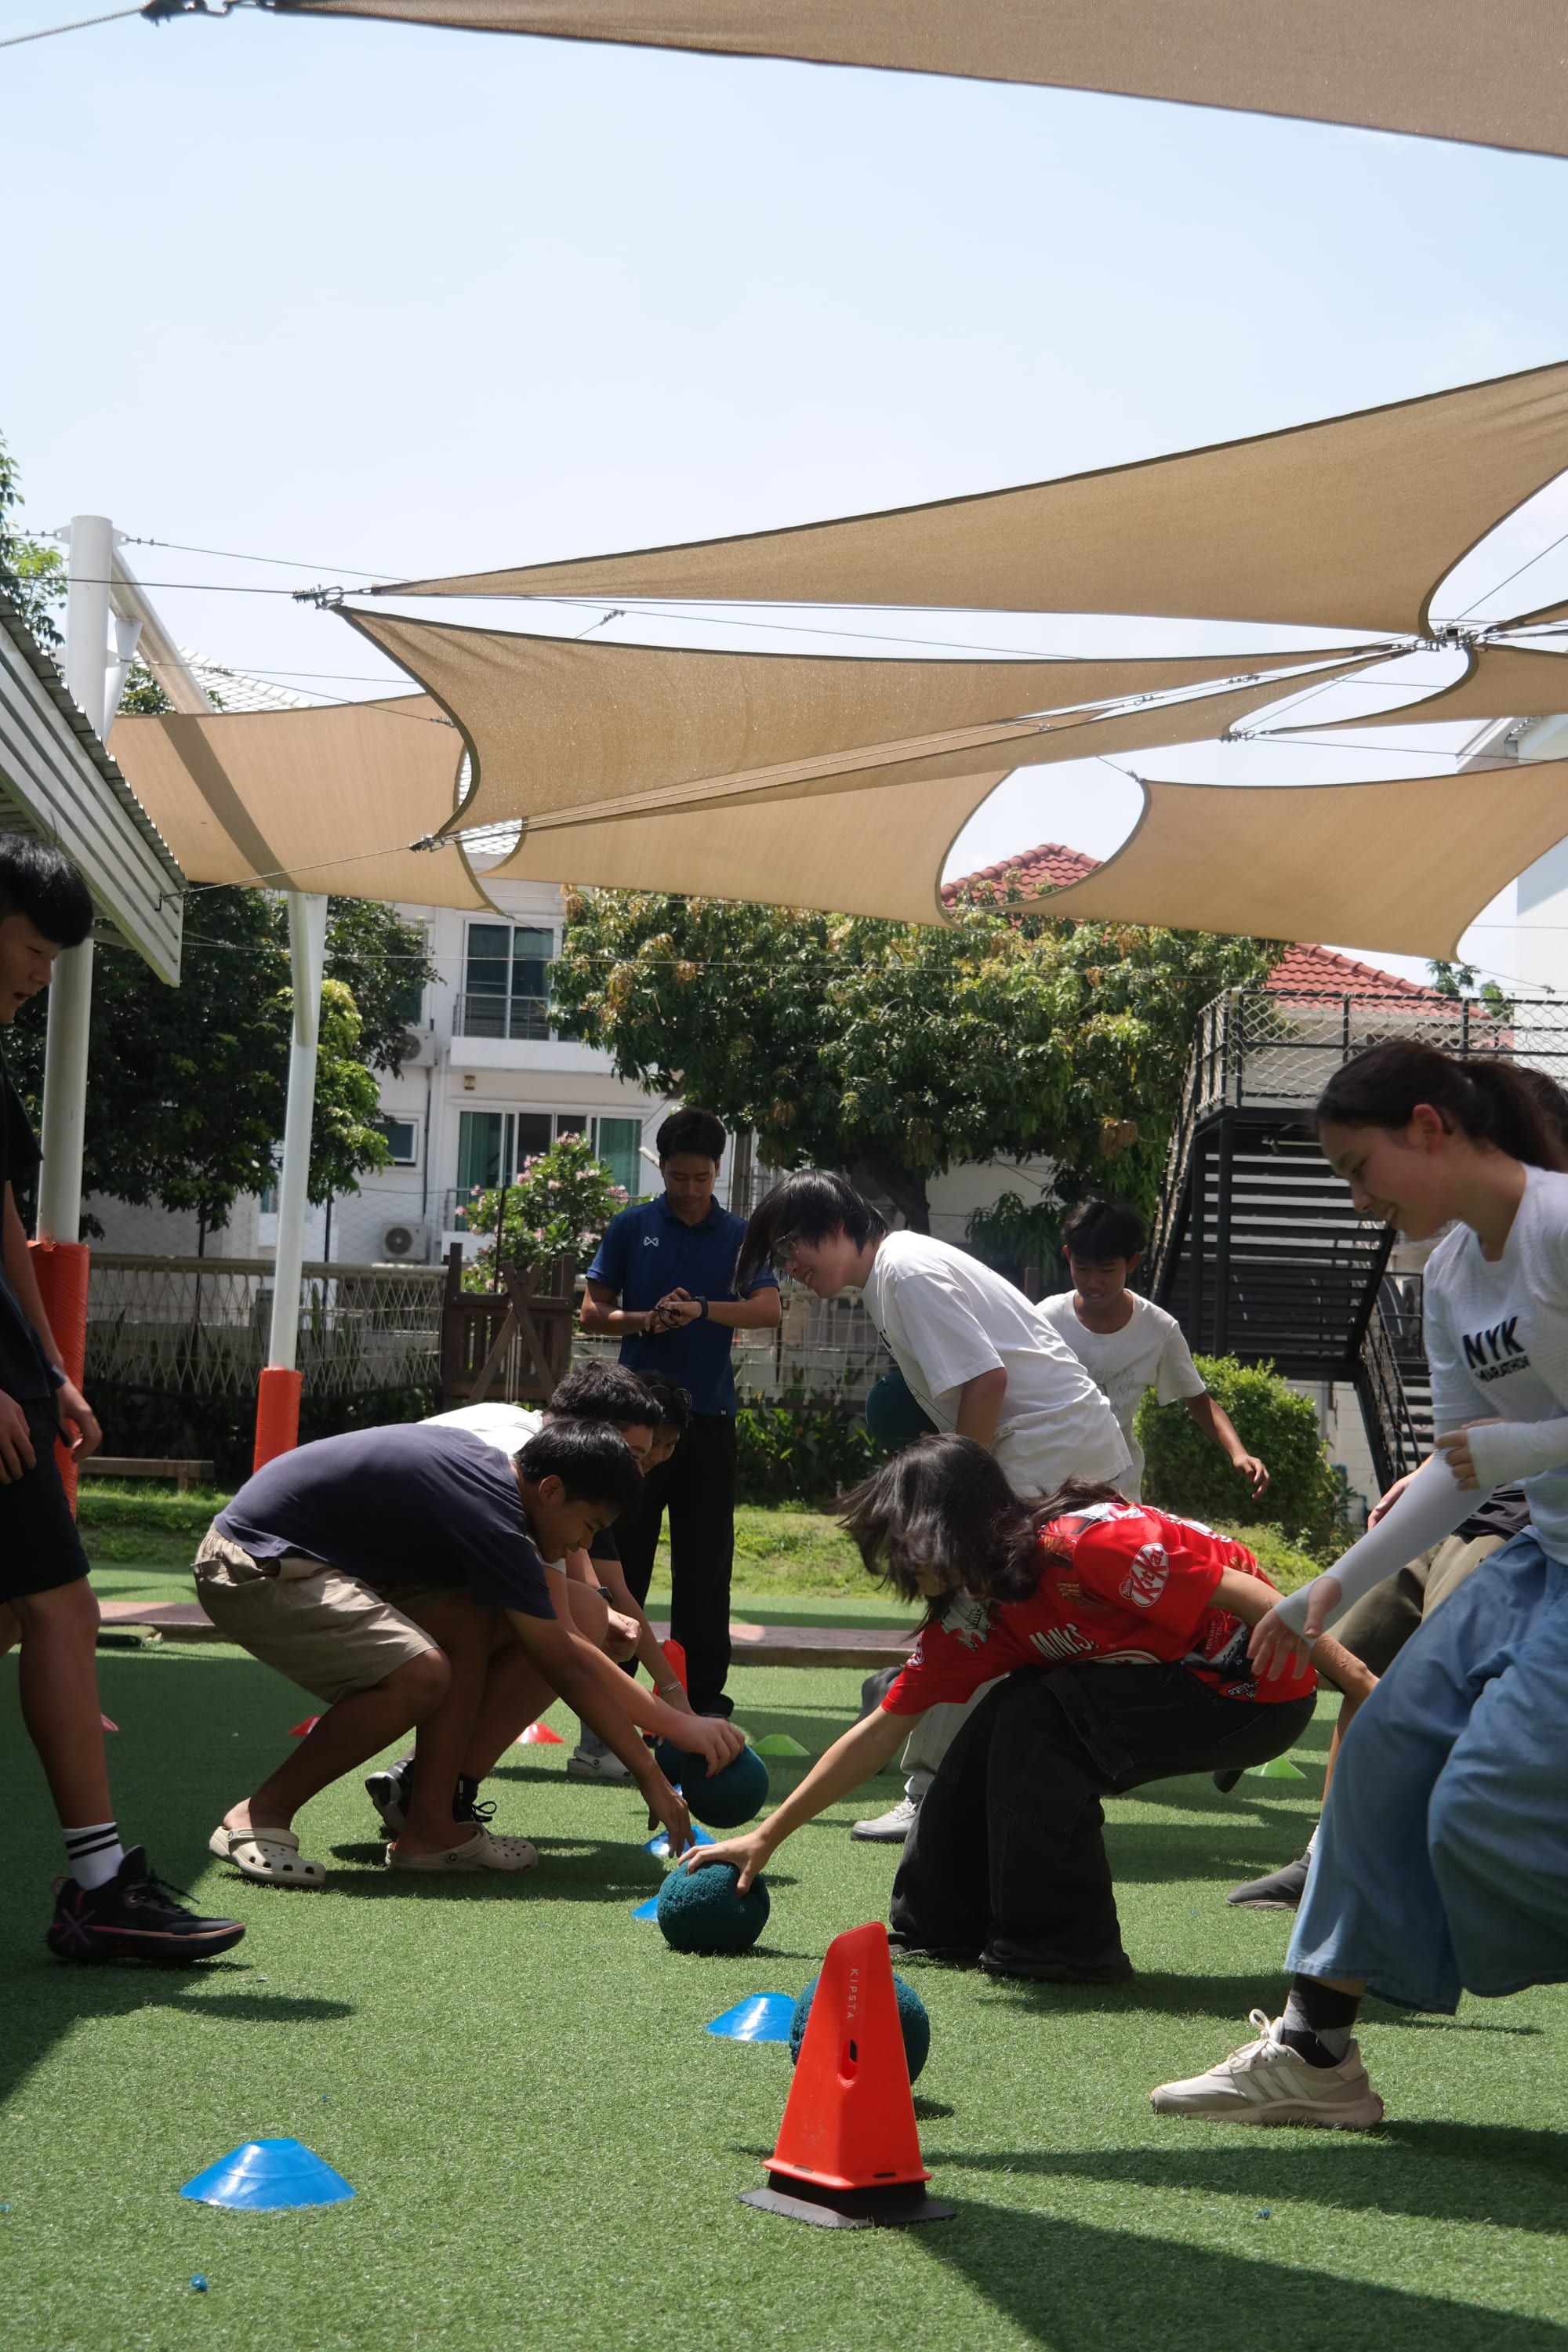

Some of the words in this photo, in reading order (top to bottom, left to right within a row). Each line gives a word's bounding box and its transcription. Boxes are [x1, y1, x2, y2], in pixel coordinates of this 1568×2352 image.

[1461, 1316, 1525, 1370] NYK
[1131, 1548, 1168, 1602] KitKat
[846, 1968, 859, 2020] KIPSTA
